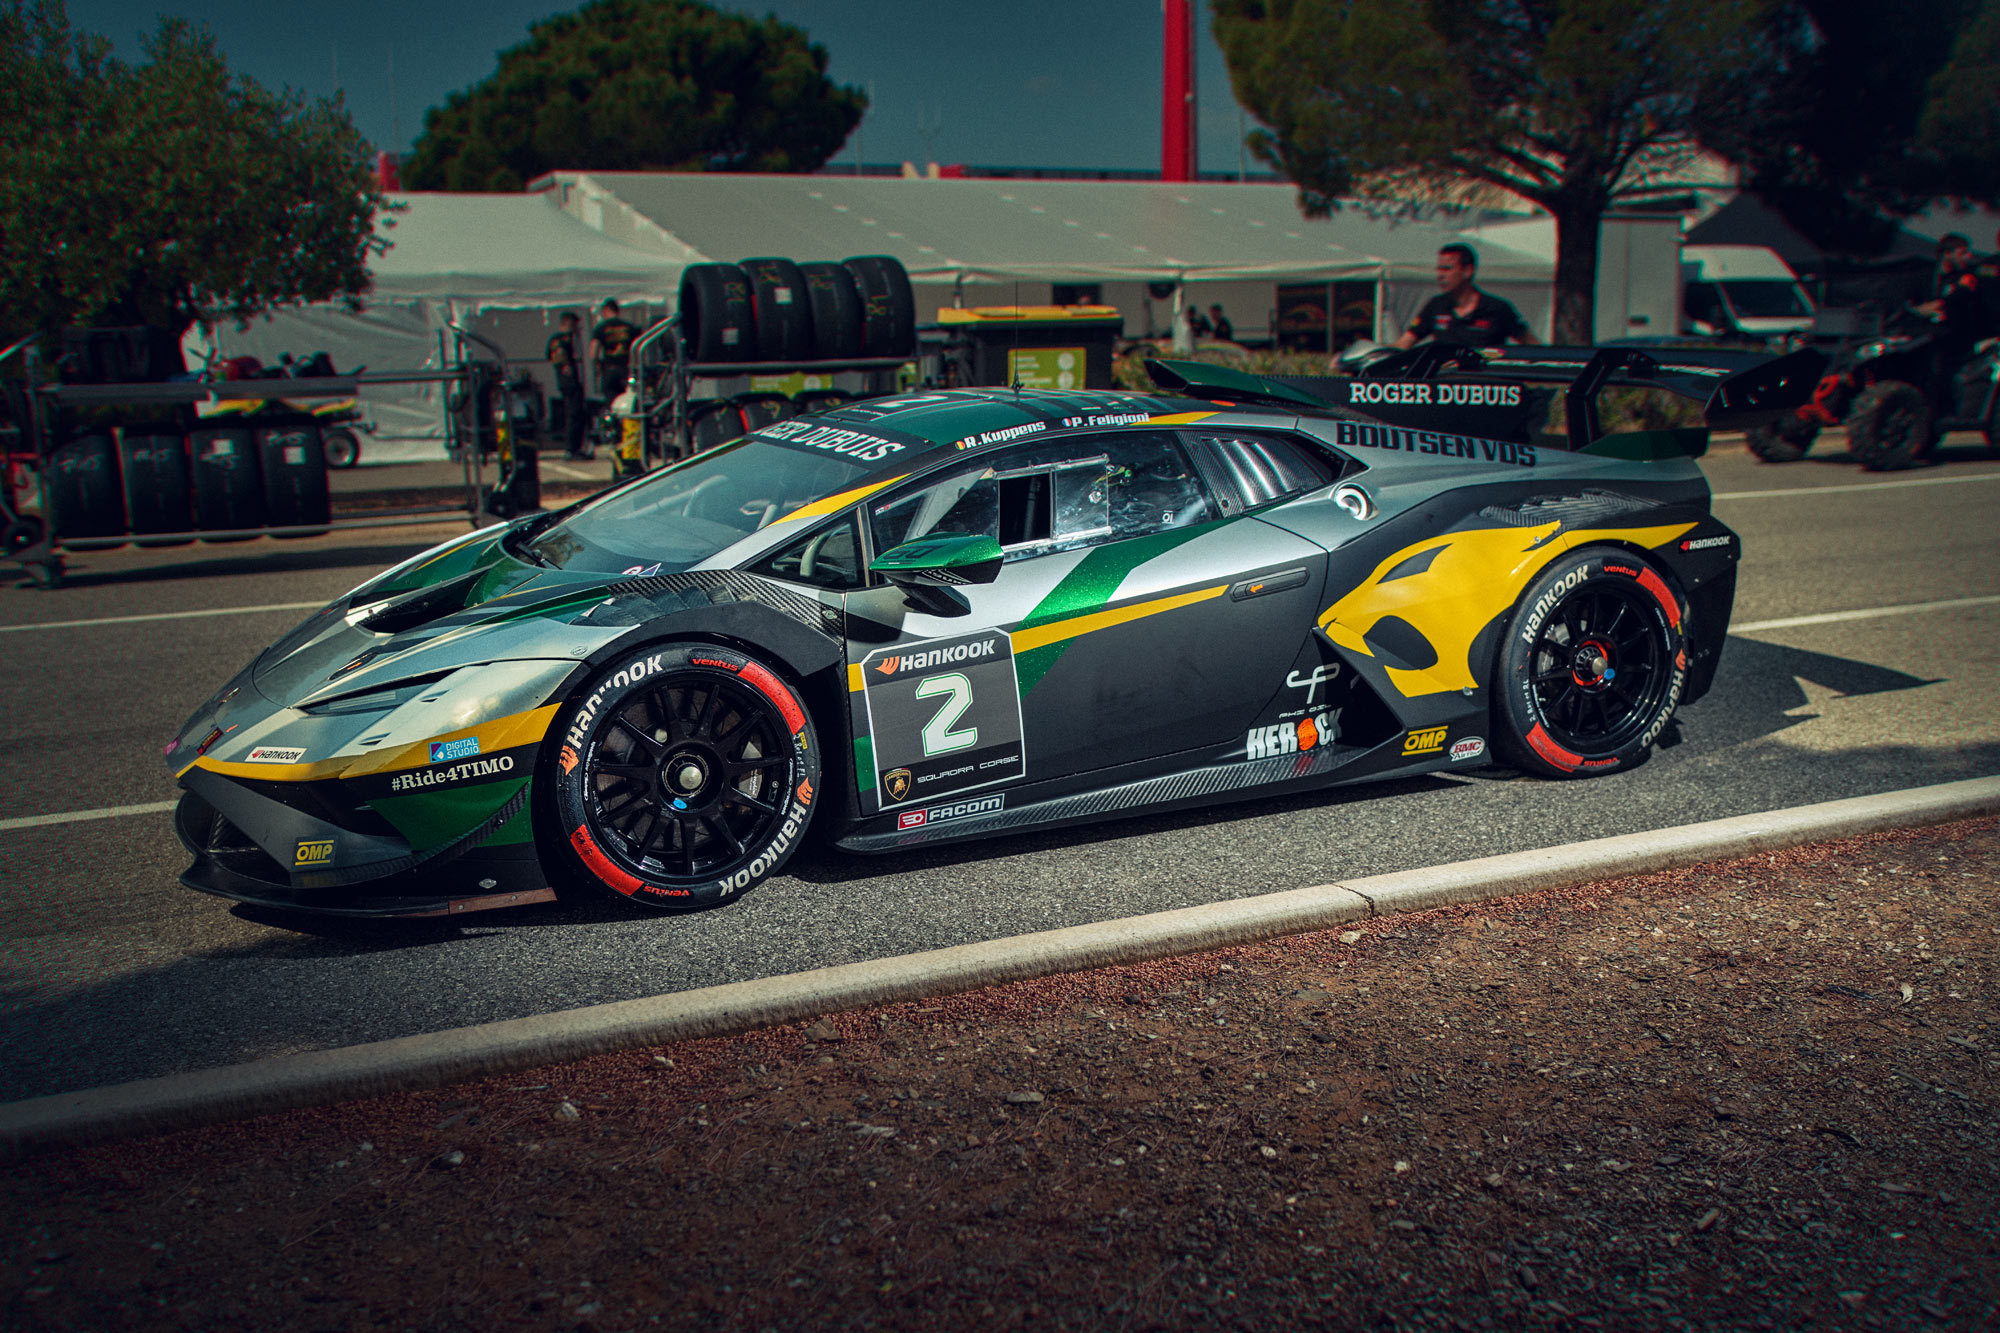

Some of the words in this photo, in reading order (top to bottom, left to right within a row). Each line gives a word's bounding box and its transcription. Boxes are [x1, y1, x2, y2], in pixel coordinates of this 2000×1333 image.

[1349, 382, 1432, 405] ROGER
[1437, 384, 1521, 406] DUBUIS
[1071, 412, 1150, 428] P.Feligioni
[791, 426, 906, 461] DUBUIS
[964, 421, 1046, 449] R.Kuppens
[1336, 421, 1476, 461] BOUTSEN
[1689, 535, 1730, 550] HANKOOK
[1521, 564, 1588, 644] HANKOOK
[900, 639, 995, 672] HANKOOK
[915, 672, 978, 757] 2
[1640, 670, 1684, 748] HANKOO
[446, 739, 479, 752] DIGITAL
[446, 744, 480, 758] STUDIO
[1404, 730, 1447, 750] OMP
[1455, 741, 1481, 753] BMC
[260, 750, 302, 761] HANKOOK
[391, 756, 515, 791] #Ride4TIMO
[917, 765, 974, 784] SQUADRA
[979, 755, 1019, 769] CORSE
[928, 798, 1001, 821] FACOM
[297, 843, 333, 860] OMP
[718, 801, 807, 897] HANKOOK
